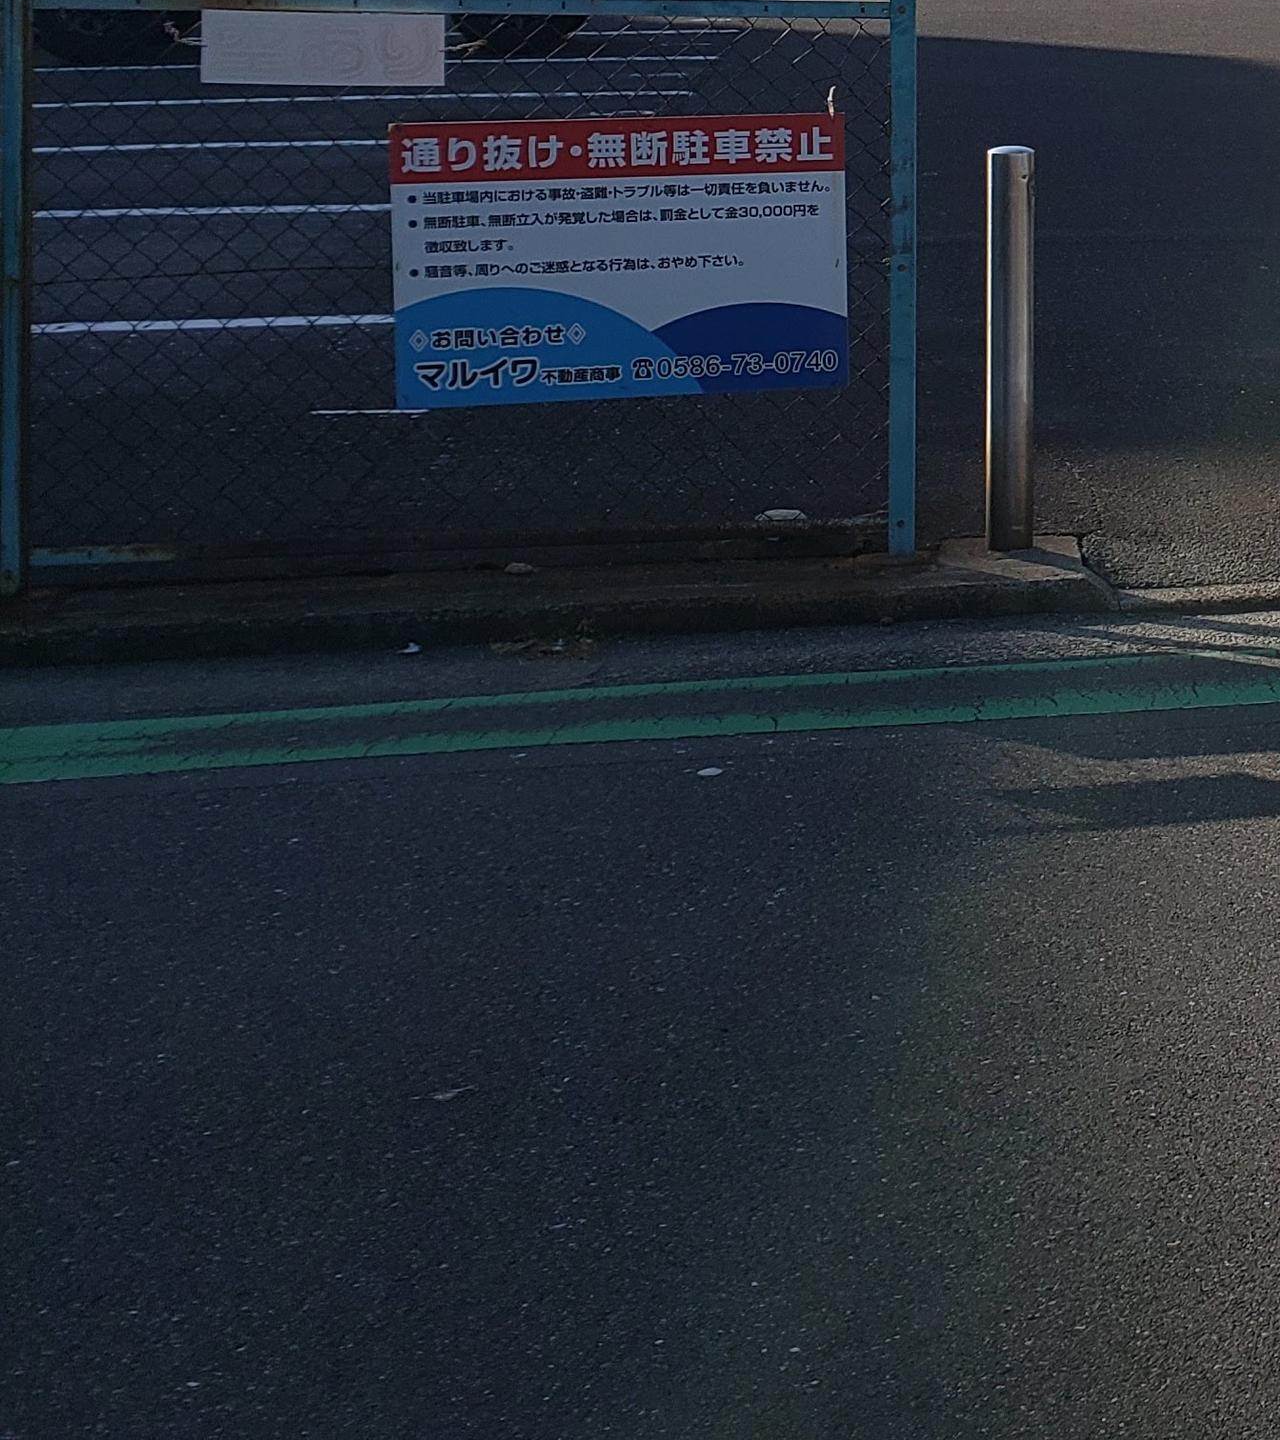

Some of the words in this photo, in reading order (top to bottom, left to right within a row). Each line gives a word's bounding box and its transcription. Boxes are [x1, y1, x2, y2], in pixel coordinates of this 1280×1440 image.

[401, 126, 834, 174] 通り抜け・無断駐車禁止
[656, 349, 839, 379] 0586-73-0740
